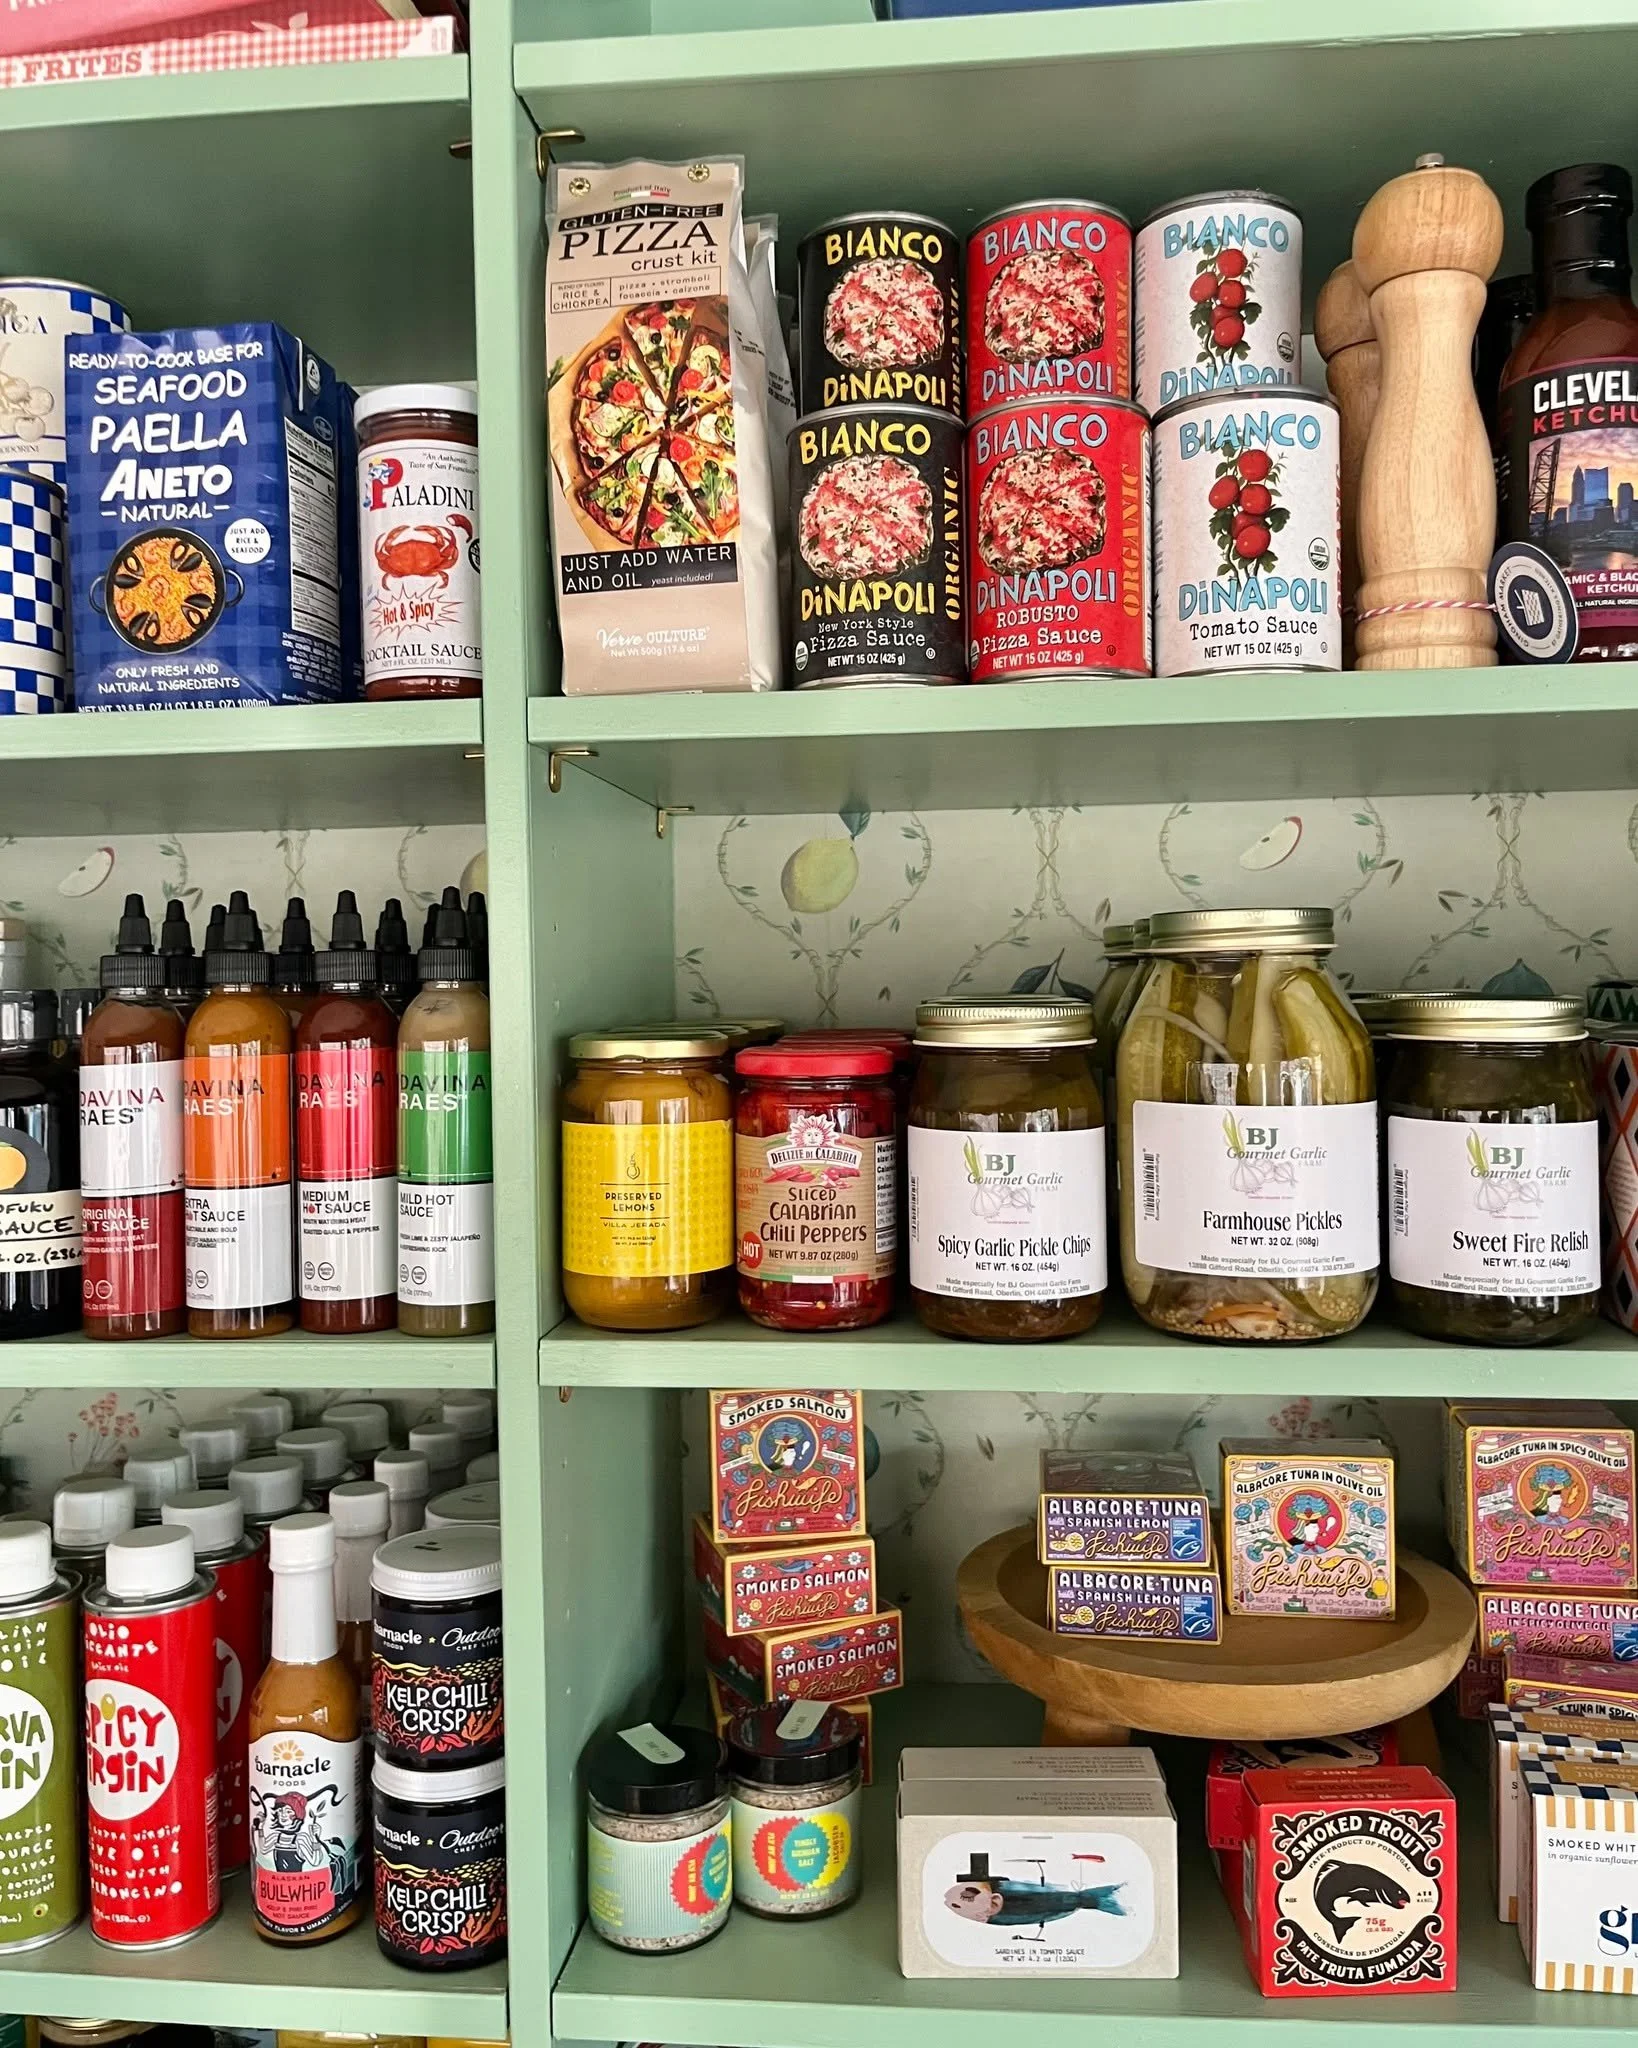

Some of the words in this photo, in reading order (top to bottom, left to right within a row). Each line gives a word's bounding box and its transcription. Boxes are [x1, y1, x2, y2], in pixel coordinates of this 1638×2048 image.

[22, 51, 142, 83] FRITES
[613, 186, 643, 197] Product
[654, 185, 671, 194] Italy
[564, 204, 718, 230] GLUTEN-FREE
[558, 220, 718, 261] PIZZA
[631, 253, 683, 272] crust
[692, 249, 717, 265] kit
[619, 281, 646, 291] pizza
[660, 273, 710, 286] stromboli
[619, 290, 661, 300] focaccia
[672, 284, 710, 295] calzone
[553, 298, 609, 311] CHICKPEA
[69, 351, 195, 370] READY-TO-COOK
[197, 345, 233, 364] BASE
[236, 342, 263, 361] FOR
[94, 369, 247, 405] SEAFOOD
[90, 410, 248, 453] PAELLA
[800, 419, 932, 465] BIANCO
[976, 412, 1108, 465] BIANCO
[1179, 411, 1321, 460] BIANCO
[100, 459, 233, 502] ANETO
[943, 467, 961, 620] ORGANIC
[564, 555, 611, 572] JUST
[620, 551, 658, 568] ADD
[665, 545, 732, 564] WATER
[565, 576, 603, 593] AND
[612, 573, 642, 588] OIL
[651, 575, 674, 587] yeast
[675, 572, 714, 584] included!
[801, 579, 935, 621] DiNAPOLI
[818, 621, 839, 634] New
[842, 618, 874, 630] York
[878, 618, 914, 630] Style
[997, 604, 1079, 629] ROBUSTO
[597, 628, 642, 649] Verve
[646, 628, 707, 644] CULTURE
[1189, 618, 1259, 641] Tomato
[1267, 616, 1318, 635] Sauce
[810, 633, 859, 654] Pizza
[867, 630, 926, 647] Sauce
[982, 632, 1029, 655] Pizza
[1037, 627, 1101, 646] Sauce
[1204, 646, 1224, 659] NET
[1226, 644, 1241, 656] WT
[1244, 644, 1254, 655] 15
[1258, 643, 1271, 654] OZ
[1274, 642, 1293, 656] (425
[1294, 643, 1302, 657] g)
[365, 643, 426, 664] COCKTAIL
[431, 643, 481, 660] SAUCE
[116, 667, 147, 679] ONLY
[151, 665, 189, 677] FRESH
[193, 663, 219, 675] AND
[97, 682, 153, 694] NATURAL
[157, 677, 241, 691] INGREDIENTS
[80, 1086, 165, 1108] DAVINA
[1246, 1127, 1279, 1150] BJ
[771, 1149, 804, 1164] DELIZIE
[815, 1147, 857, 1165] CALABRIA
[1227, 1146, 1285, 1159] Gourmet
[1290, 1146, 1327, 1160] Garlic
[303, 1190, 349, 1202] MEDIUM
[400, 1192, 422, 1206] MILD
[425, 1194, 455, 1206] HOT
[605, 1192, 662, 1201] PRESERVED
[82, 1207, 137, 1219] ORIGINAL
[201, 1210, 246, 1222] SAUCE
[400, 1204, 434, 1218] SAUCE
[613, 1203, 655, 1212] LEMONS
[1203, 1210, 1291, 1231] Farmhouse
[1296, 1211, 1342, 1231] Pickles
[938, 1234, 970, 1259] Spicy
[975, 1237, 1015, 1257] Garlic
[1020, 1236, 1058, 1257] Pickle
[1062, 1234, 1091, 1258] Chips
[1453, 1230, 1507, 1253] Sweet
[1513, 1232, 1546, 1253] Fire
[1551, 1230, 1589, 1252] Relish
[769, 1250, 783, 1259] NET
[785, 1251, 798, 1260] WT
[800, 1251, 817, 1260] 9.87
[820, 1251, 832, 1261] OZ
[833, 1250, 859, 1261] (280g)
[1221, 1257, 1256, 1266] especially
[1282, 1257, 1311, 1265] Gourmet
[1313, 1256, 1330, 1264] Garlic
[1477, 1445, 1520, 1464] ALBACORE
[1522, 1441, 1546, 1453] TUNA
[1548, 1441, 1557, 1450] IN
[1560, 1442, 1586, 1455] SPICY
[1587, 1451, 1612, 1466] OLIVE
[1613, 1458, 1627, 1467] OIL
[1236, 1472, 1288, 1494] ALBACORE
[1292, 1469, 1319, 1480] TUNA
[1322, 1470, 1333, 1482] IN
[1336, 1474, 1364, 1493] OLIVE
[1366, 1486, 1383, 1497] OIL
[735, 1476, 843, 1517] Fishwife
[735, 1577, 800, 1597] SMOKED
[804, 1567, 870, 1589] SALMON
[1507, 1618, 1519, 1626] IN
[1522, 1618, 1553, 1628] SPICY
[1556, 1620, 1589, 1630] OLIVE
[1593, 1621, 1611, 1631] OIL
[456, 1643, 478, 1652] CHEF
[482, 1639, 498, 1648] LIFE
[776, 1653, 835, 1679] SMOKED
[838, 1638, 897, 1664] SALMON
[386, 1681, 429, 1711] KELP
[431, 1682, 488, 1709] CHILI
[402, 1708, 467, 1734] CRISP
[255, 1755, 331, 1777] barnacle
[1292, 1815, 1362, 1861] SMOKED
[1368, 1816, 1425, 1857] TROUT
[2, 1854, 56, 1875] OLIVES
[1559, 1853, 1592, 1863] organic
[1595, 1855, 1638, 1866] sunflower
[7, 1880, 55, 1900] TUSCANY
[8, 1872, 54, 1890] BOTTLED
[387, 1880, 428, 1911] KELP
[430, 1883, 487, 1911] CHILI
[274, 1925, 299, 1933] FLAVOR
[402, 1910, 466, 1936] CRISP
[1365, 1917, 1387, 1927] 75g
[1313, 1931, 1353, 1957] CONSERVAS
[1369, 1930, 1406, 1955] PORTUGAL
[1296, 1940, 1320, 1963] PATE
[1319, 1958, 1365, 1979] TRUTA
[1367, 1939, 1424, 1978] FUMADA
